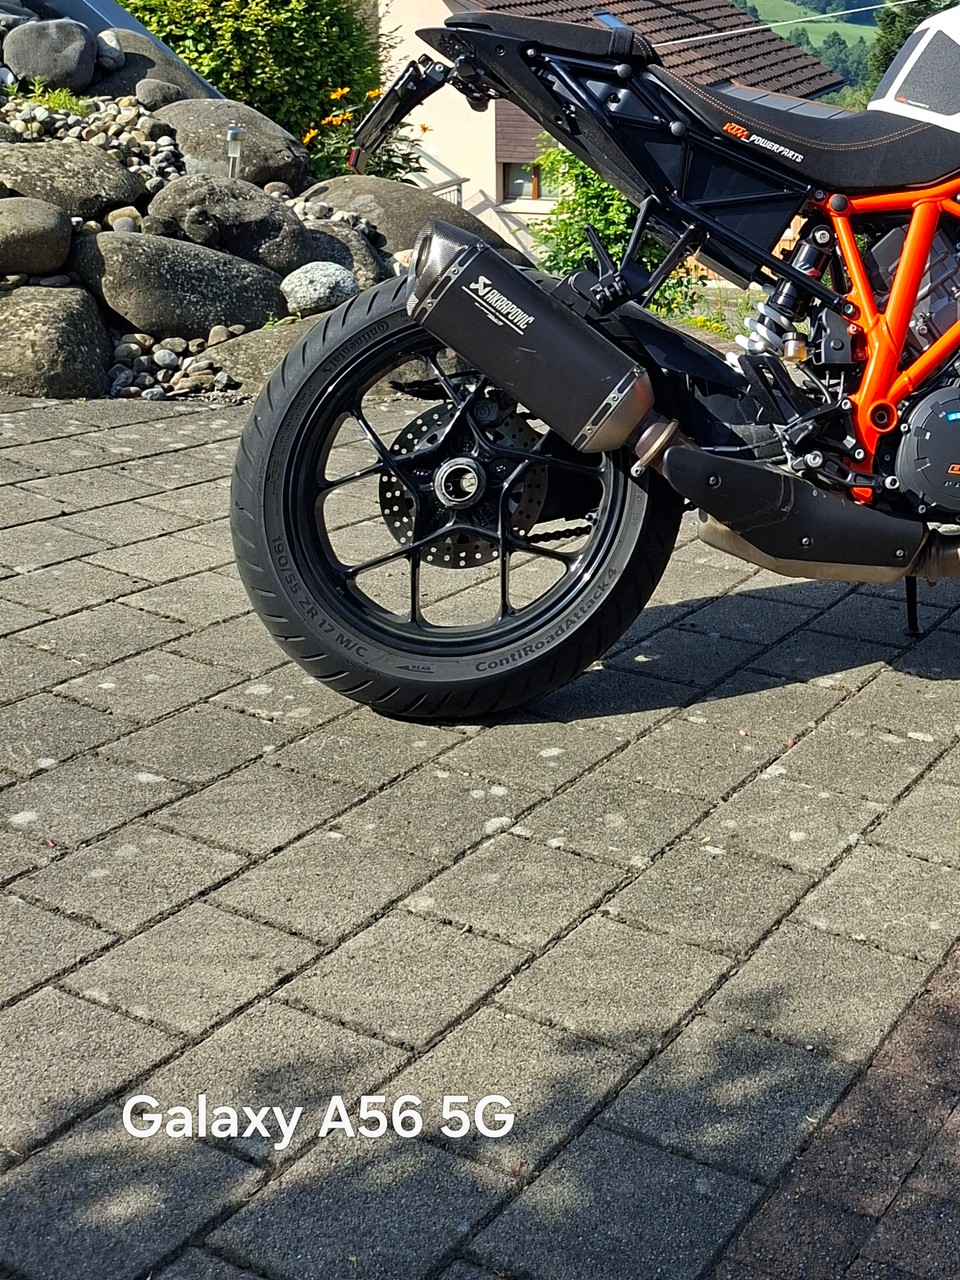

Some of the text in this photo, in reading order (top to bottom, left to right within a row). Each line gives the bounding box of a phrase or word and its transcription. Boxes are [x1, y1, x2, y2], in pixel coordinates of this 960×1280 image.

[749, 134, 804, 163] POWERPARTS
[272, 535, 301, 595] 190/55
[334, 632, 368, 658] M/C
[474, 580, 611, 672] ContiRoadAttack
